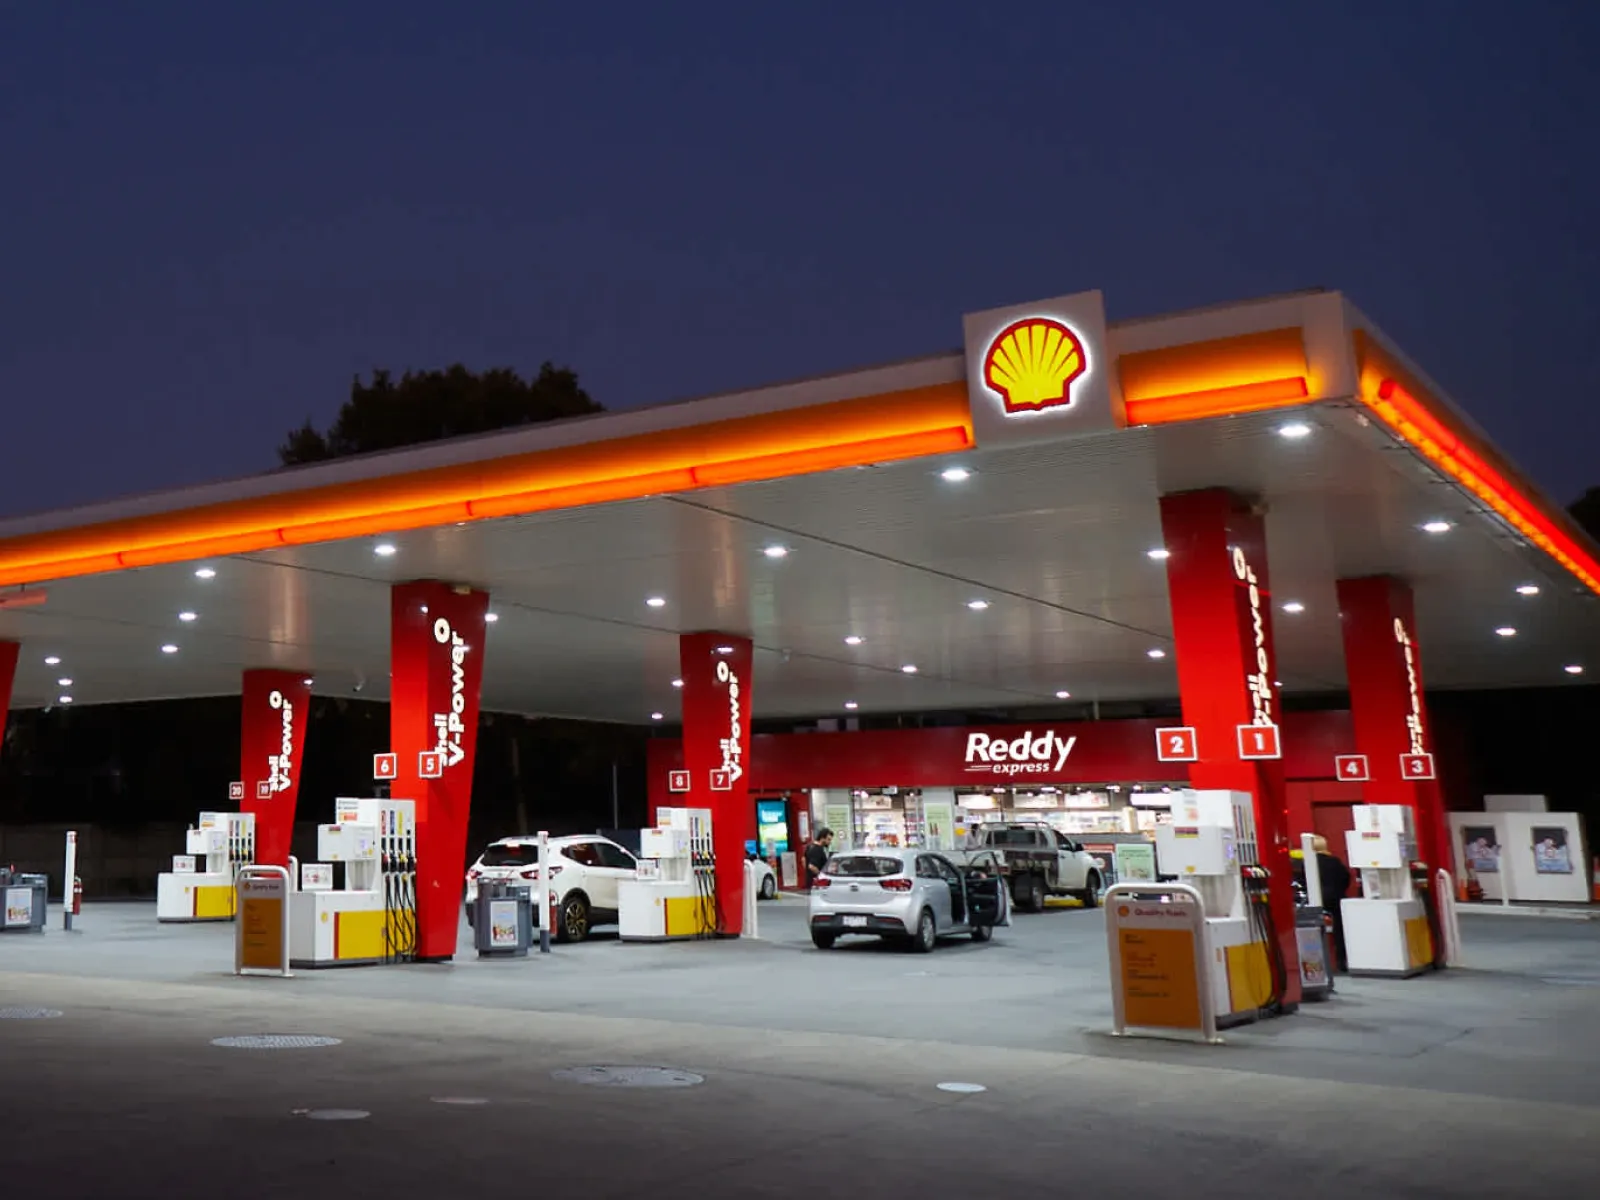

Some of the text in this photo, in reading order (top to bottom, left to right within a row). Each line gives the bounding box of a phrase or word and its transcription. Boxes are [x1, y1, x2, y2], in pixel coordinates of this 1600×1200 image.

[447, 632, 465, 767] V-Power
[1248, 675, 1261, 726] hell
[729, 672, 742, 782] V-Power
[1170, 736, 1184, 753] 2
[1254, 733, 1264, 750] 1
[965, 730, 1076, 771] Reddy
[381, 760, 390, 773] 6
[426, 758, 434, 772] 5
[992, 761, 1050, 775] express
[1346, 761, 1358, 775] 4
[1411, 759, 1424, 775] 3
[676, 775, 683, 786] 8
[717, 774, 724, 785] 7
